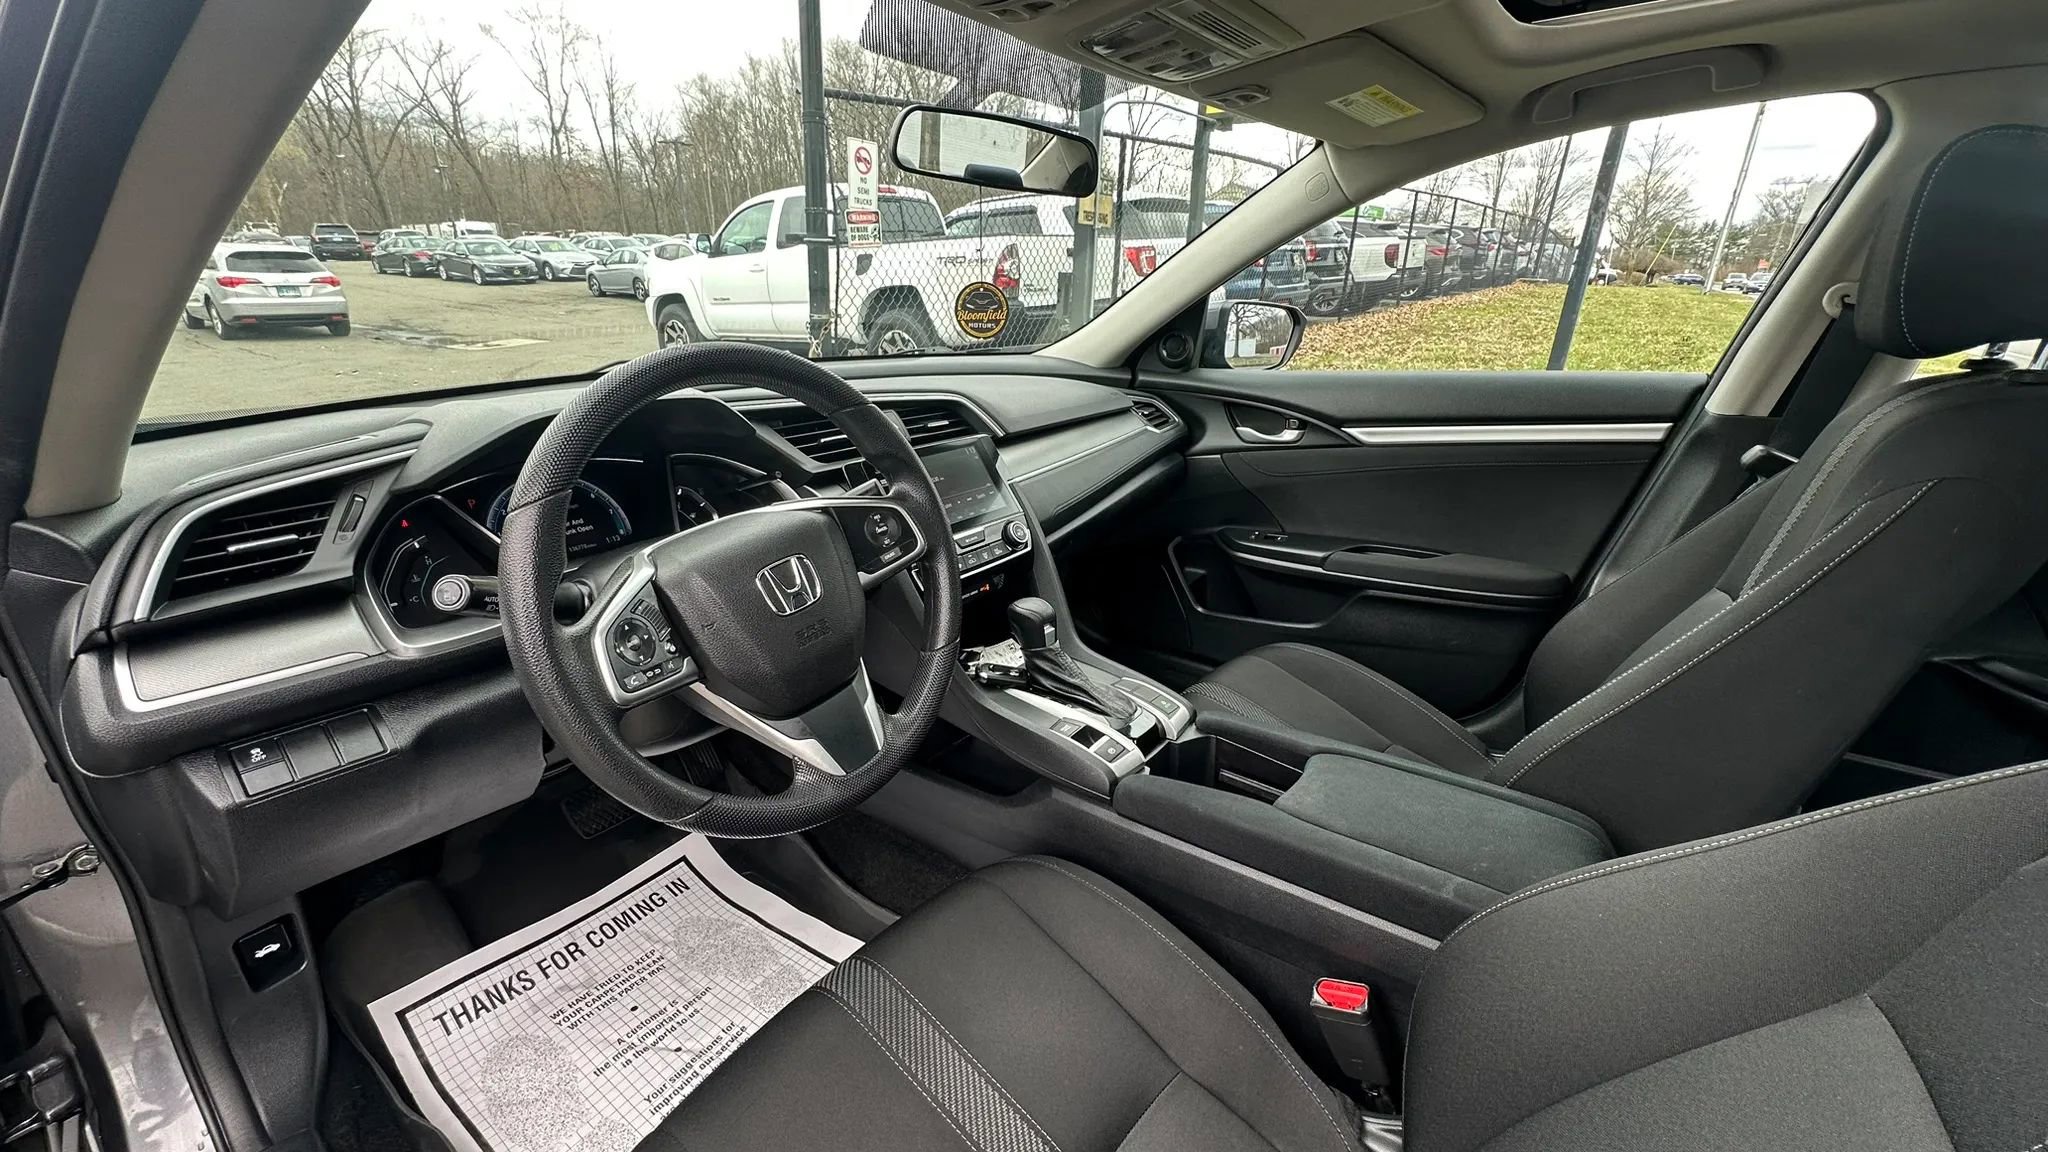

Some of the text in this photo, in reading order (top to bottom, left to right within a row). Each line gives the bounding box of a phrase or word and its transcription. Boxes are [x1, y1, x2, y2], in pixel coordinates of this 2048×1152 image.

[854, 197, 873, 206] TRUCKS
[857, 187, 869, 195] SEMI
[858, 233, 870, 241] DOGS
[937, 256, 966, 266] TRD
[957, 309, 1008, 322] Bloomfield
[577, 525, 594, 533] Open
[251, 755, 266, 763] OFF
[432, 877, 690, 1036] THANKS FOR COMING IN
[550, 949, 656, 1020] WE HAVE TRIED TO KEEP
[556, 955, 665, 1027] YOUR CARPETING CLEAN
[567, 963, 667, 1030] WITH THIS PAPER MAT
[593, 986, 712, 1077] the most important person
[616, 999, 679, 1046] A customer is
[621, 1007, 704, 1068] in the world to us.
[643, 1083, 668, 1103] Your
[668, 1035, 723, 1083] suggestions
[721, 1021, 737, 1035] for
[649, 1070, 700, 1116] improving
[699, 1054, 716, 1070] our
[716, 1024, 748, 1056] service
